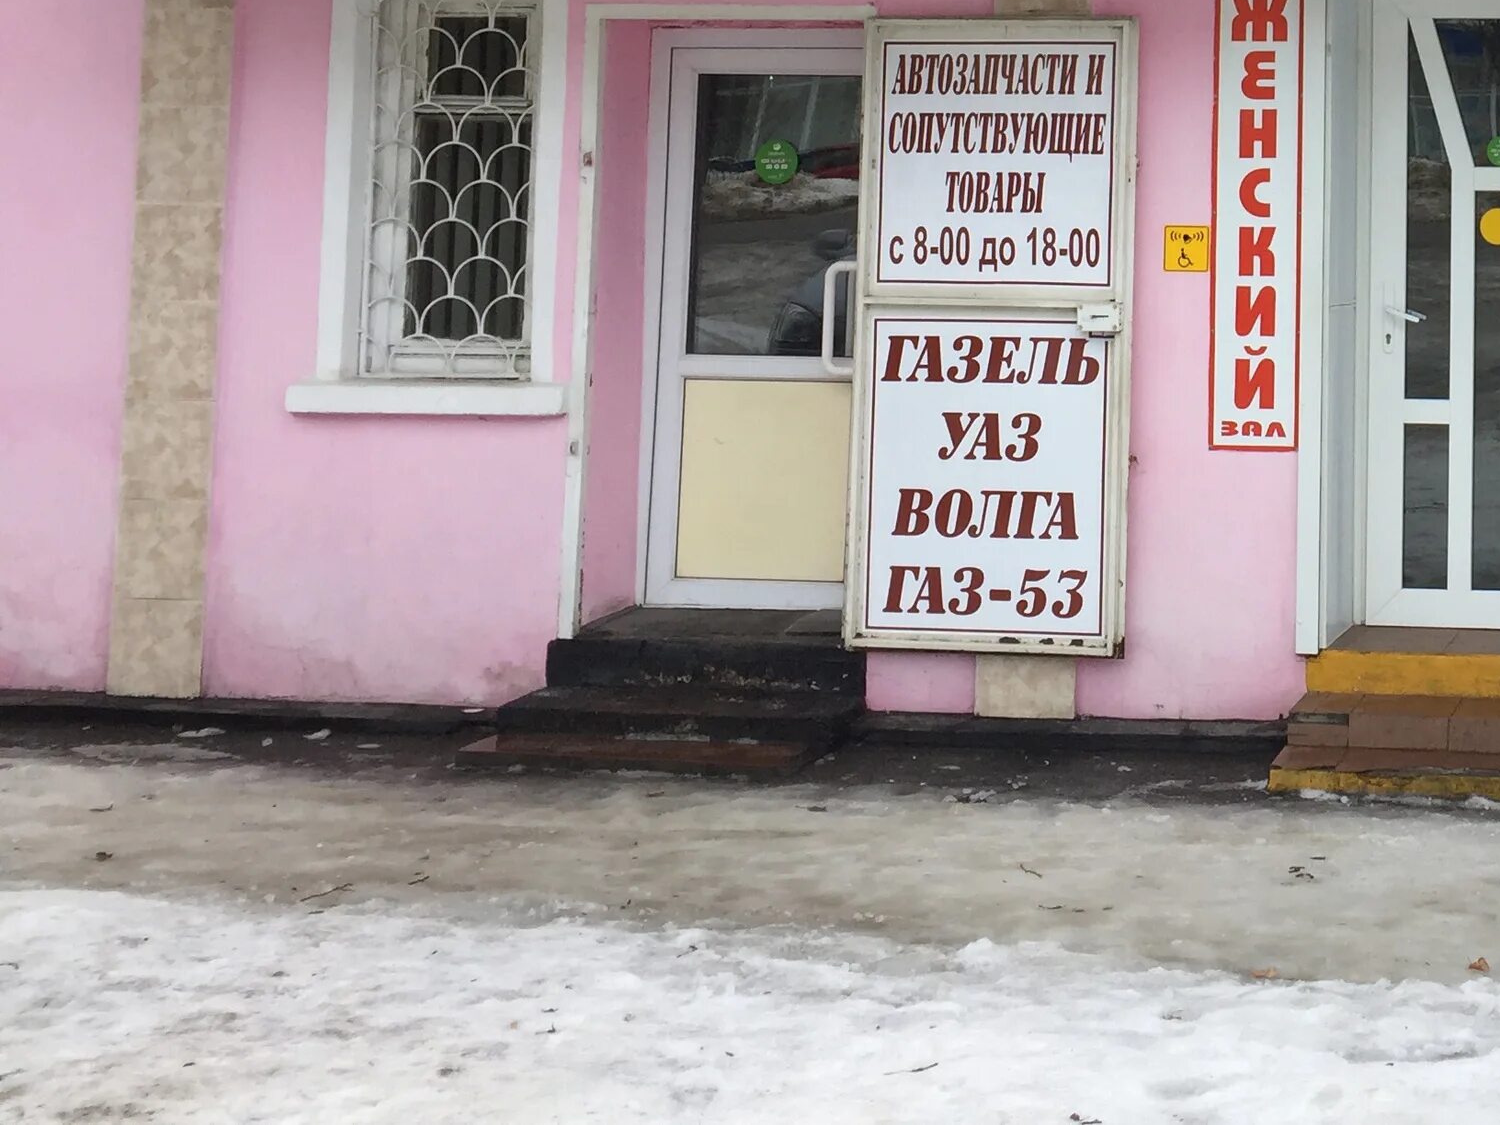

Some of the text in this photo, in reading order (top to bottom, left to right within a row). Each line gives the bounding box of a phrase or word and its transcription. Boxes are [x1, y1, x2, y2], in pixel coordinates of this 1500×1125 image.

[892, 53, 1105, 95] АВТОЗАПЧАСТИ И
[889, 112, 1106, 162] СОПУТСТВУЮЩИЕ
[946, 172, 1046, 213] ТОВАРЫ
[913, 226, 970, 266] 8-00
[979, 236, 1015, 272] до
[1026, 227, 1100, 267] 18-00
[881, 335, 1100, 385] ГАЗЕЛЬ
[938, 412, 1042, 462] УАЗ
[1221, 420, 1286, 438] ЗАЛ
[892, 489, 1079, 540] ВОЛГА
[882, 566, 1088, 618] ГАЗ-53
